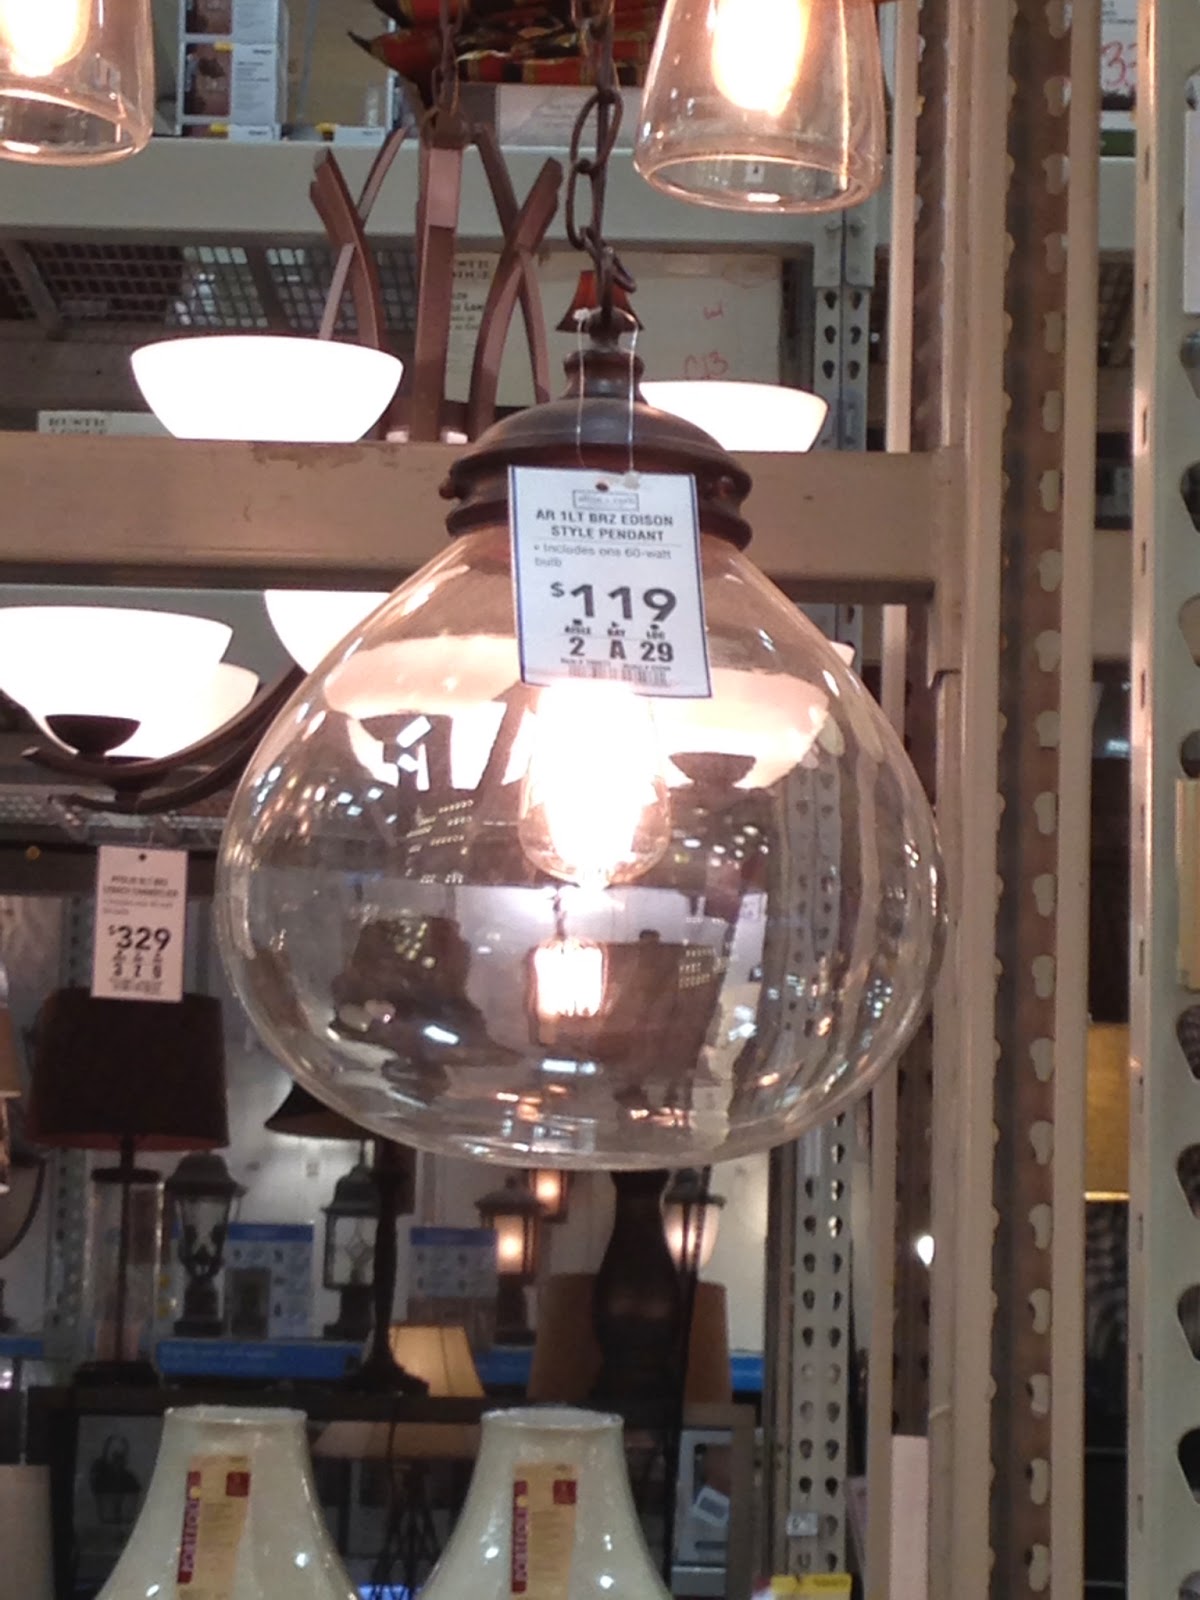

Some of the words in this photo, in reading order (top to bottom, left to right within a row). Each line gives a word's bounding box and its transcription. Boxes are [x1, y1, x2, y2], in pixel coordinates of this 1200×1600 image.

[536, 509, 556, 521] AR
[561, 511, 584, 523] 1LT
[589, 512, 616, 525] BRZ
[621, 514, 674, 527] EDISON
[551, 526, 594, 539] STYLE
[599, 528, 664, 542] PENDANT
[543, 543, 596, 556] Includes
[624, 547, 672, 560] 60-watt
[534, 556, 563, 568] bulb
[550, 581, 678, 622] $119
[569, 636, 586, 657] 2
[609, 639, 627, 660] A
[640, 642, 675, 663] 29
[107, 924, 172, 951] $329
